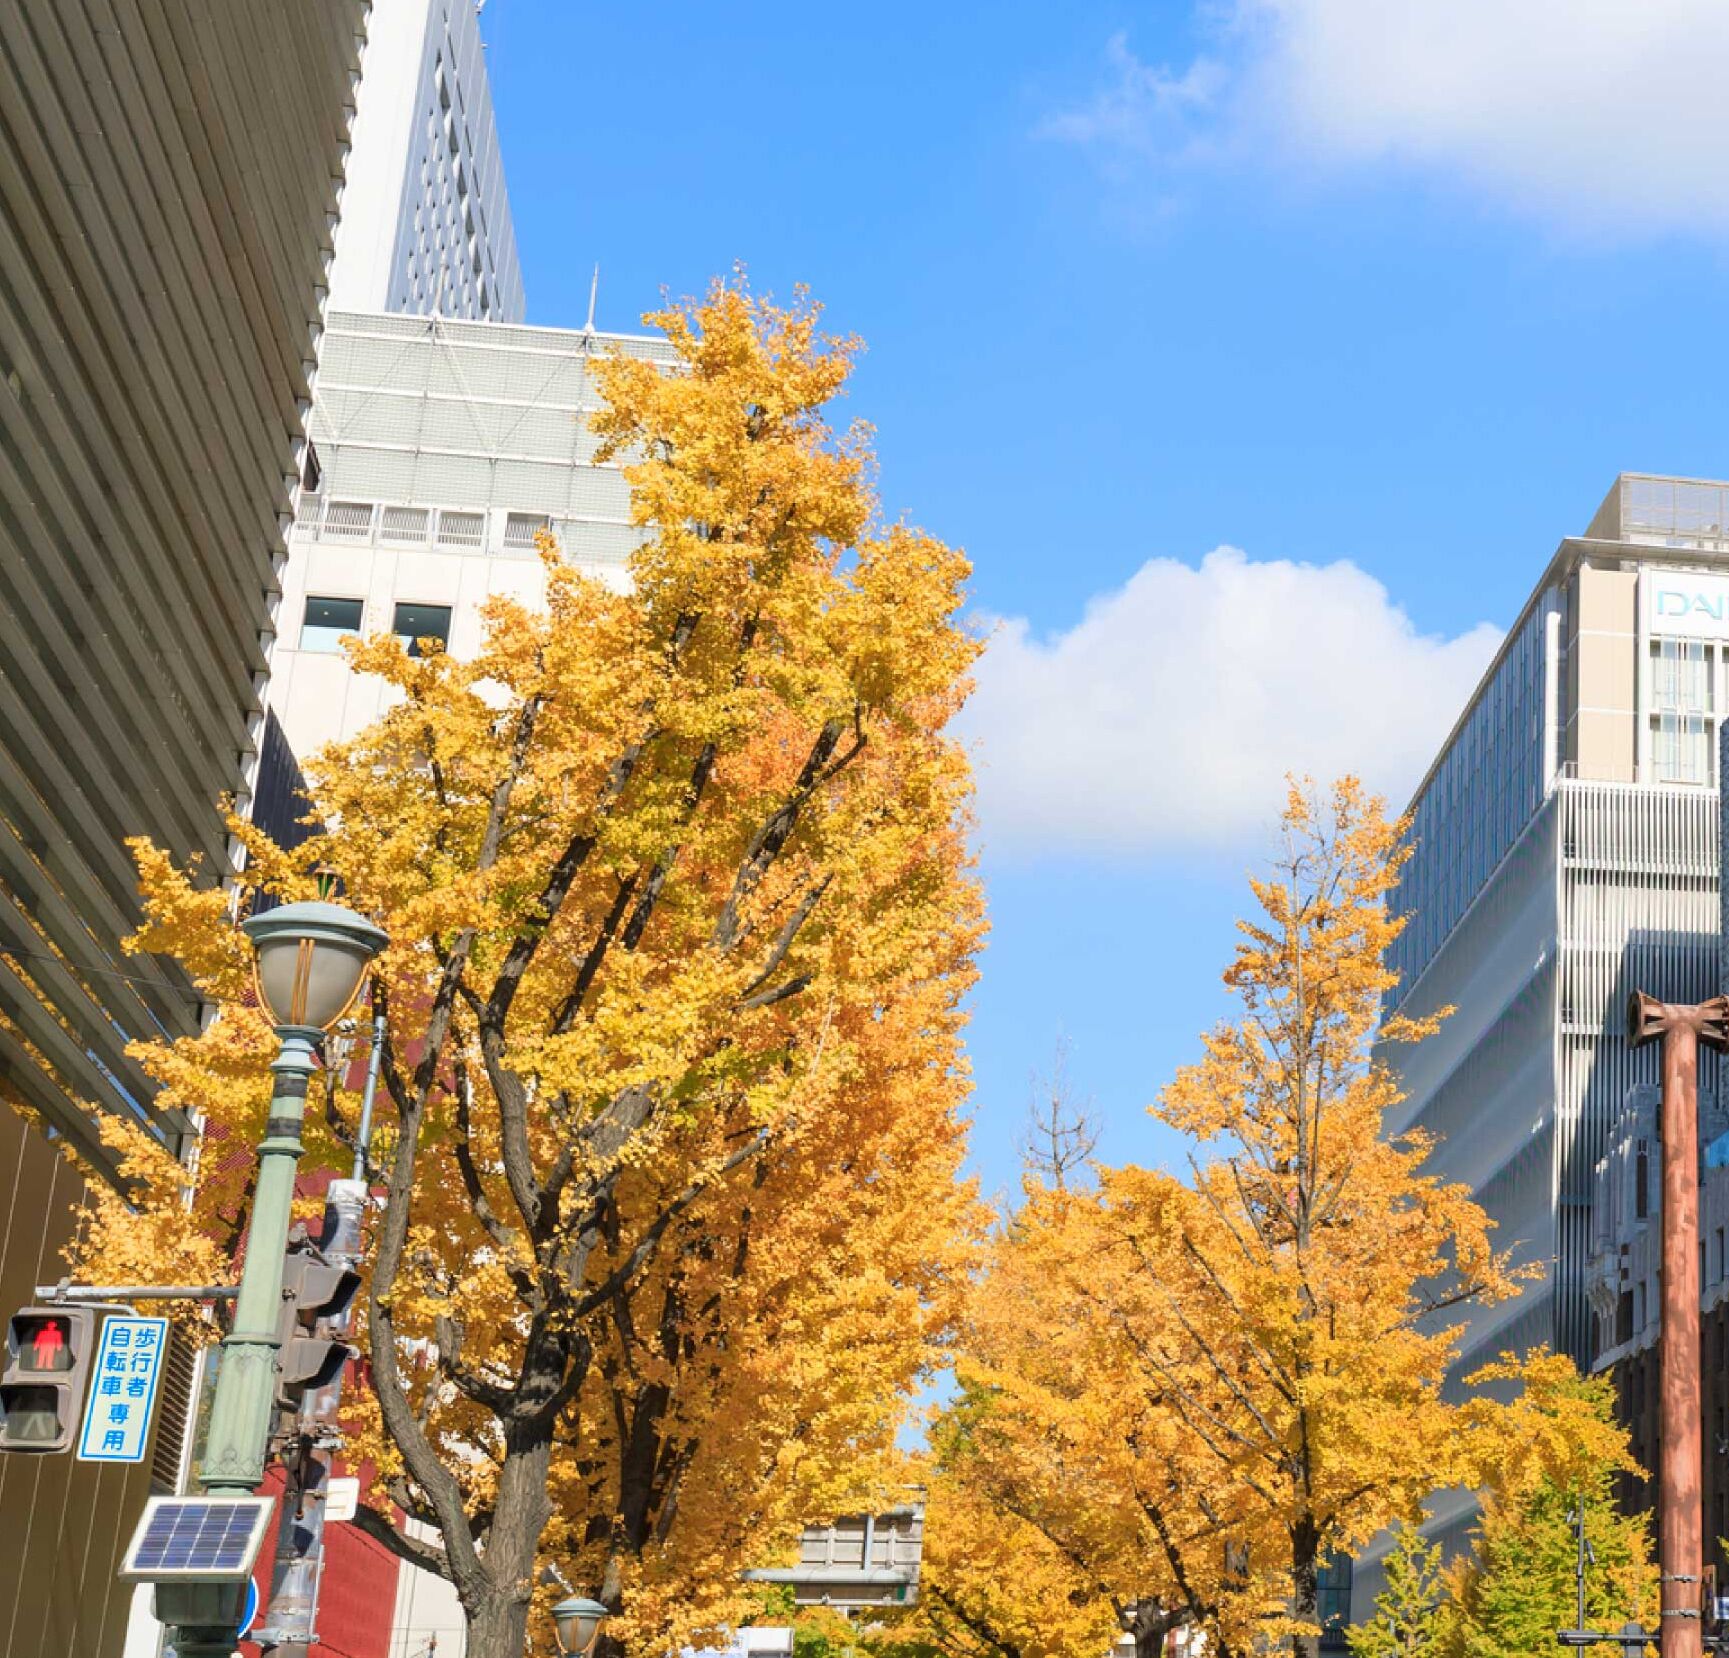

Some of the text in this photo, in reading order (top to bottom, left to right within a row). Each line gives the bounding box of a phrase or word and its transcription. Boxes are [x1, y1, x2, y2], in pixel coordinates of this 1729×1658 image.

[100, 1326, 131, 1396] 自転車
[126, 1326, 157, 1398] 歩行者
[102, 1403, 130, 1451] 専用
